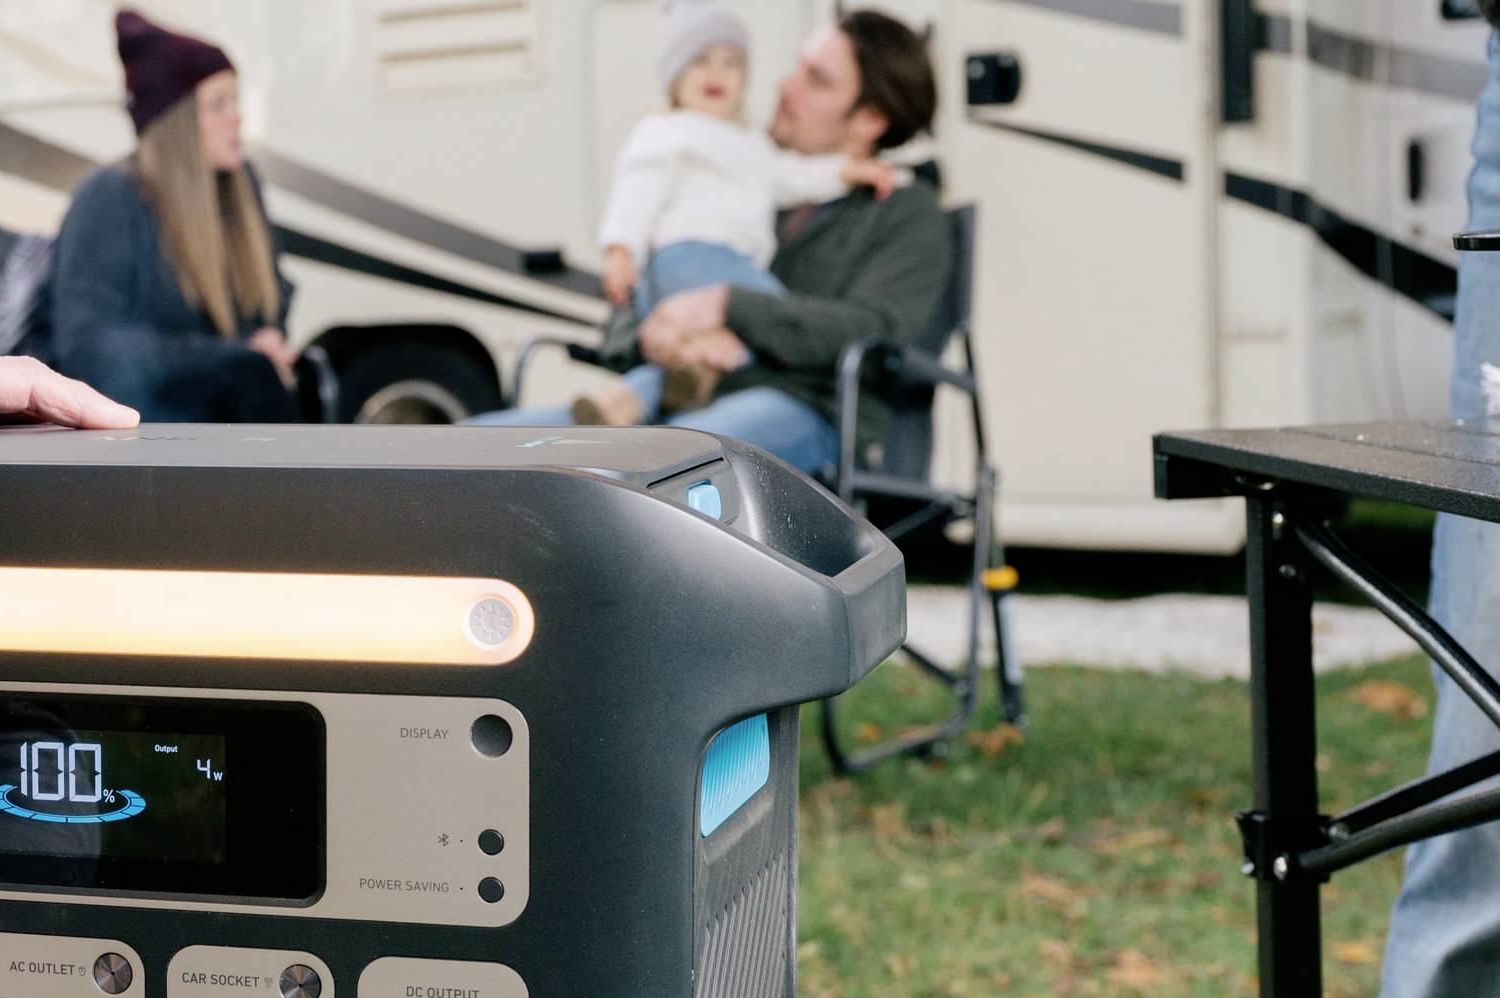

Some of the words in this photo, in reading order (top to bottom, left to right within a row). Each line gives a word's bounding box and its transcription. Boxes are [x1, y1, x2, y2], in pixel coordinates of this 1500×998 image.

[400, 726, 449, 740] DISPLAY
[154, 744, 178, 754] Output
[359, 877, 402, 892] POWER
[404, 879, 451, 894] SAVING
[9, 960, 26, 974] AC
[28, 962, 75, 976] OUTLET
[181, 971, 207, 985] CAR
[210, 973, 260, 988] SOCKET
[405, 985, 423, 998] DC
